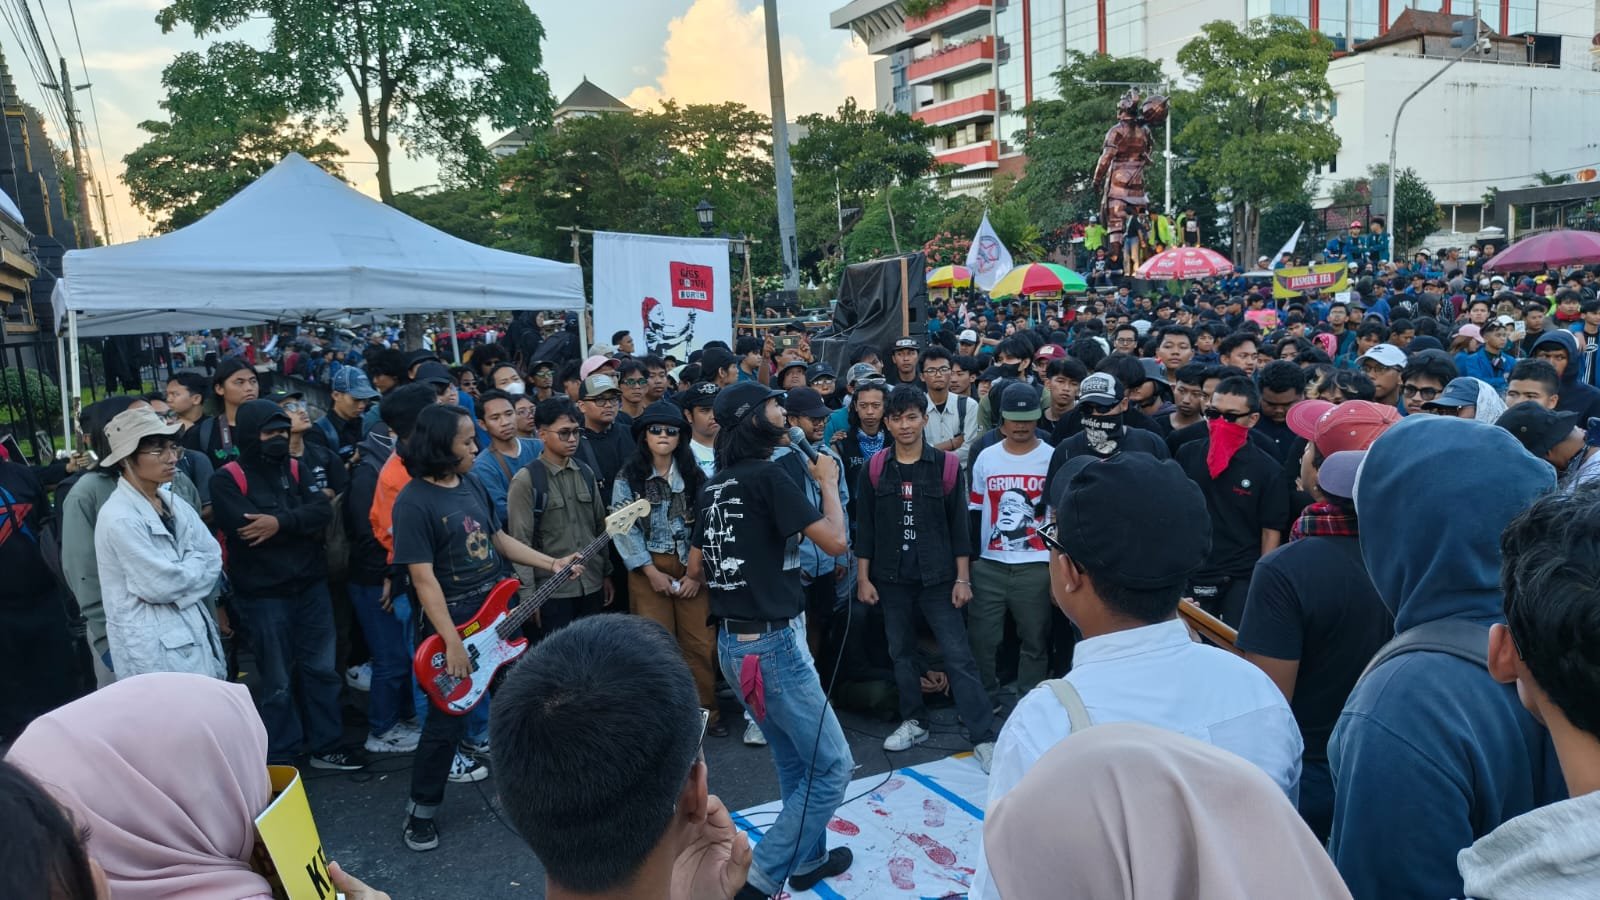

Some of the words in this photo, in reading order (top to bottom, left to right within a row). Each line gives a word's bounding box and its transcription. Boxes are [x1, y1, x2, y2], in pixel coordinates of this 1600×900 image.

[1291, 274, 1317, 288] JASMINE
[1320, 273, 1331, 283] TEA
[904, 529, 916, 540] SU
